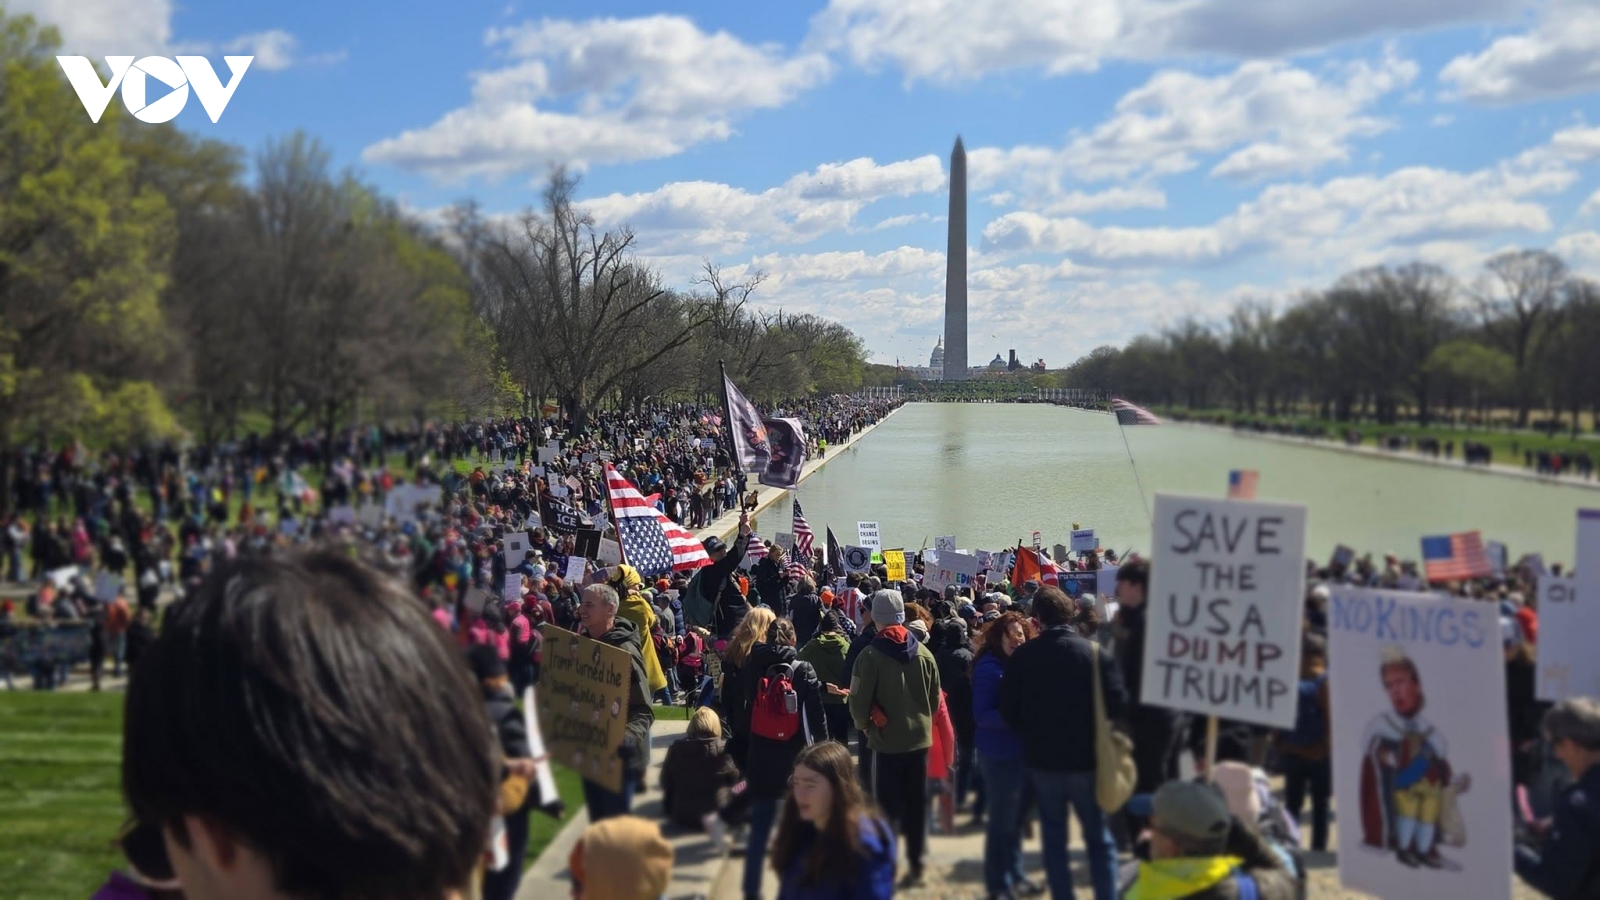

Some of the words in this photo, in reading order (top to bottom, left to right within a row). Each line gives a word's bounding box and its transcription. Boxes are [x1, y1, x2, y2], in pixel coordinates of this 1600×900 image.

[556, 513, 577, 527] ICE
[1171, 509, 1284, 554] SAVE
[1195, 562, 1256, 591] THE
[1168, 593, 1266, 638] USA
[1167, 632, 1283, 671] DUMP
[575, 659, 605, 683] turned
[606, 661, 622, 687] the
[1155, 659, 1288, 710] TRUMP
[580, 686, 596, 704] into
[599, 693, 606, 708] a
